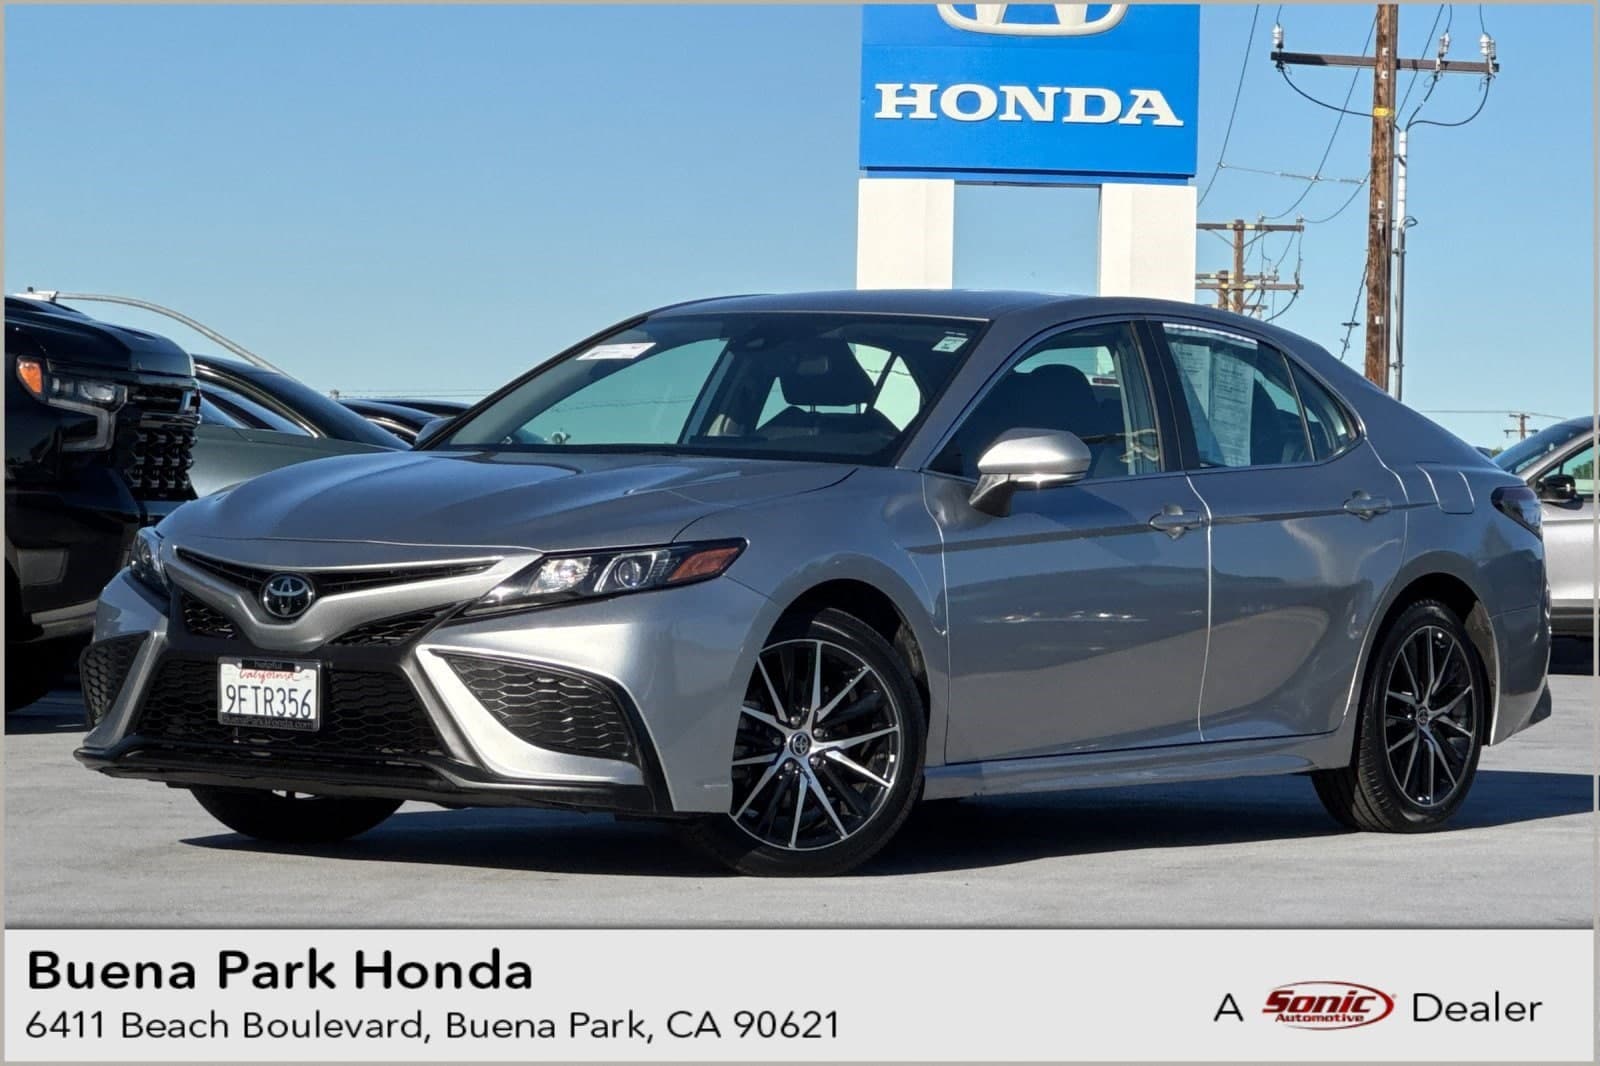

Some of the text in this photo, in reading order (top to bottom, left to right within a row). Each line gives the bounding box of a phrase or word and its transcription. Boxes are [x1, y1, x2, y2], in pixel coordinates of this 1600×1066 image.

[875, 83, 1184, 127] HONDA
[240, 669, 296, 684] California
[226, 684, 312, 719] 9FTR356
